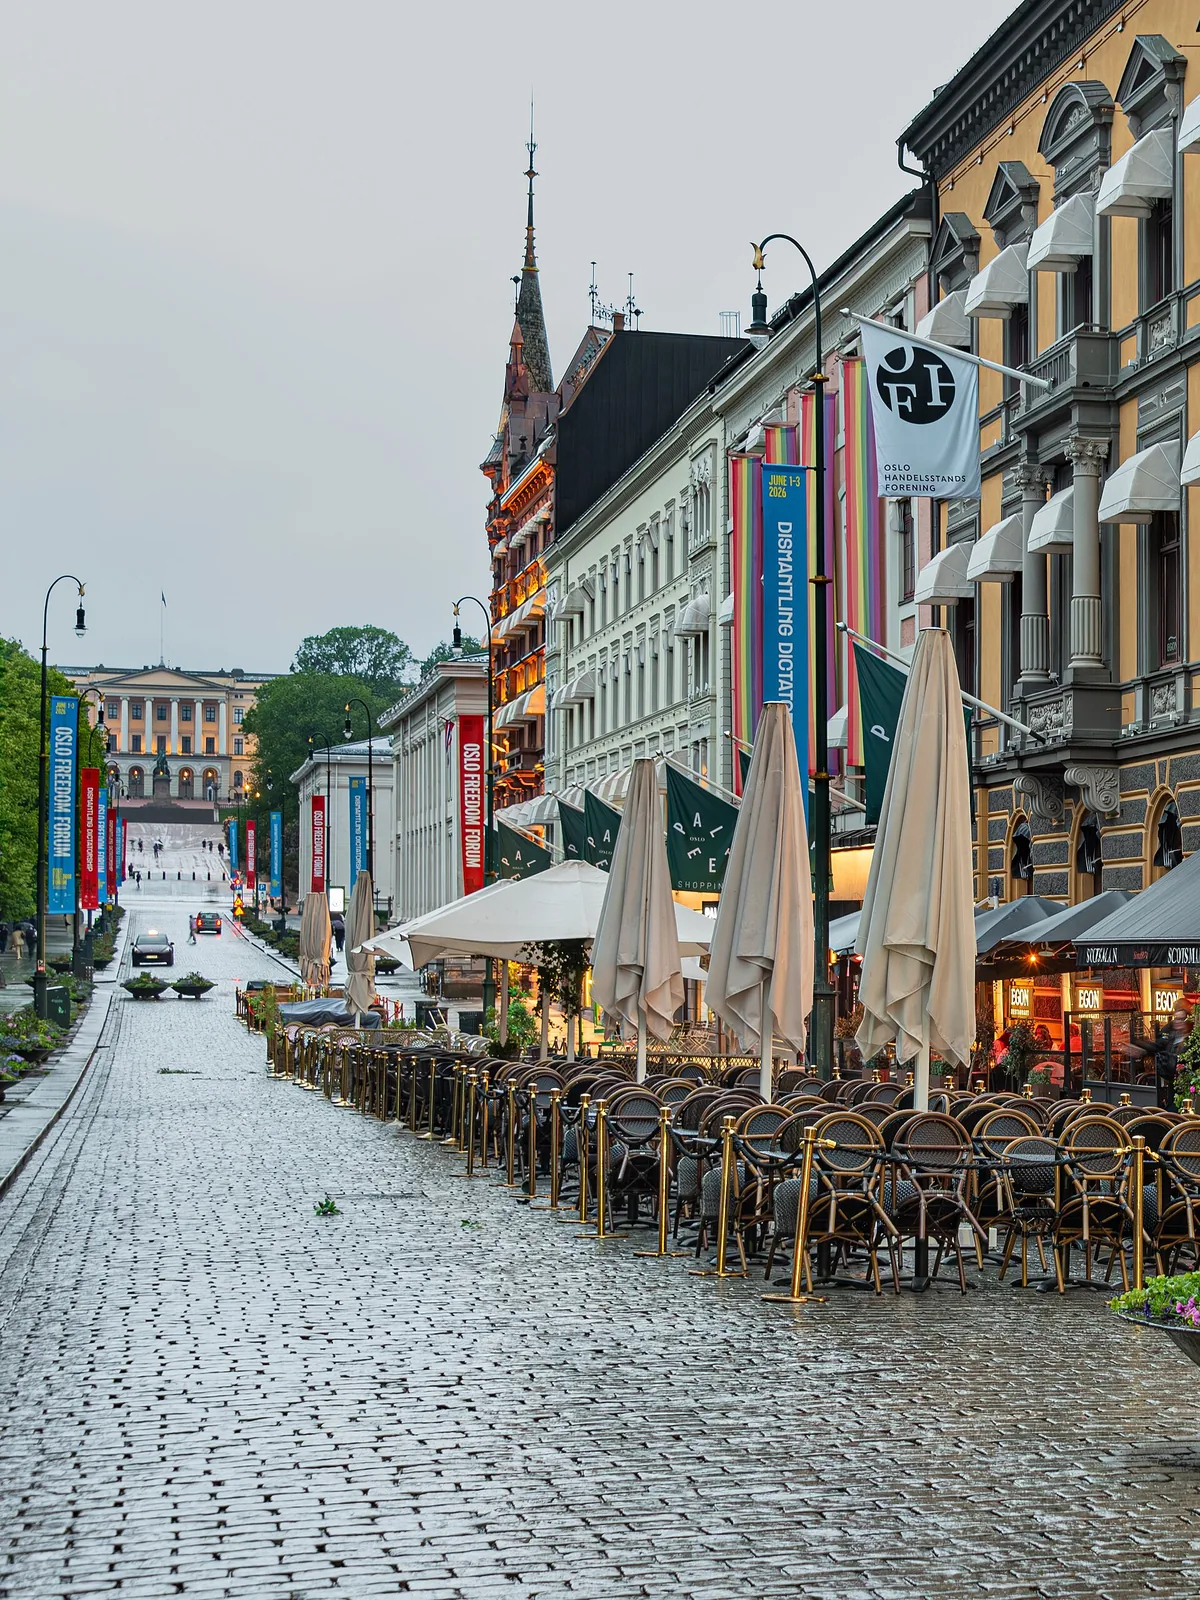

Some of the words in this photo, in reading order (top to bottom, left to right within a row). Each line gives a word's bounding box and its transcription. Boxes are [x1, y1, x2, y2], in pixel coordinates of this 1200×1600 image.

[884, 464, 911, 472] OSLO
[884, 474, 966, 482] HANDELSSTANDS
[769, 474, 787, 486] JUNE
[789, 475, 800, 487] 1-3
[769, 486, 787, 498] 2026
[885, 484, 936, 492] FORENING
[778, 521, 793, 637] DISMANTLING
[778, 642, 793, 724] DICTATO
[55, 727, 73, 756] OSLO
[463, 743, 480, 772] OSLO
[53, 758, 72, 813] FREEDOM
[464, 773, 480, 825] FREEDOM
[314, 810, 323, 827] OSLO
[53, 817, 71, 857] FORUM
[314, 827, 323, 855] FREEDOM
[465, 828, 481, 868] FORUM
[314, 856, 323, 877] FORUM
[1011, 988, 1029, 1007] EGON
[1078, 989, 1100, 1009] EGON
